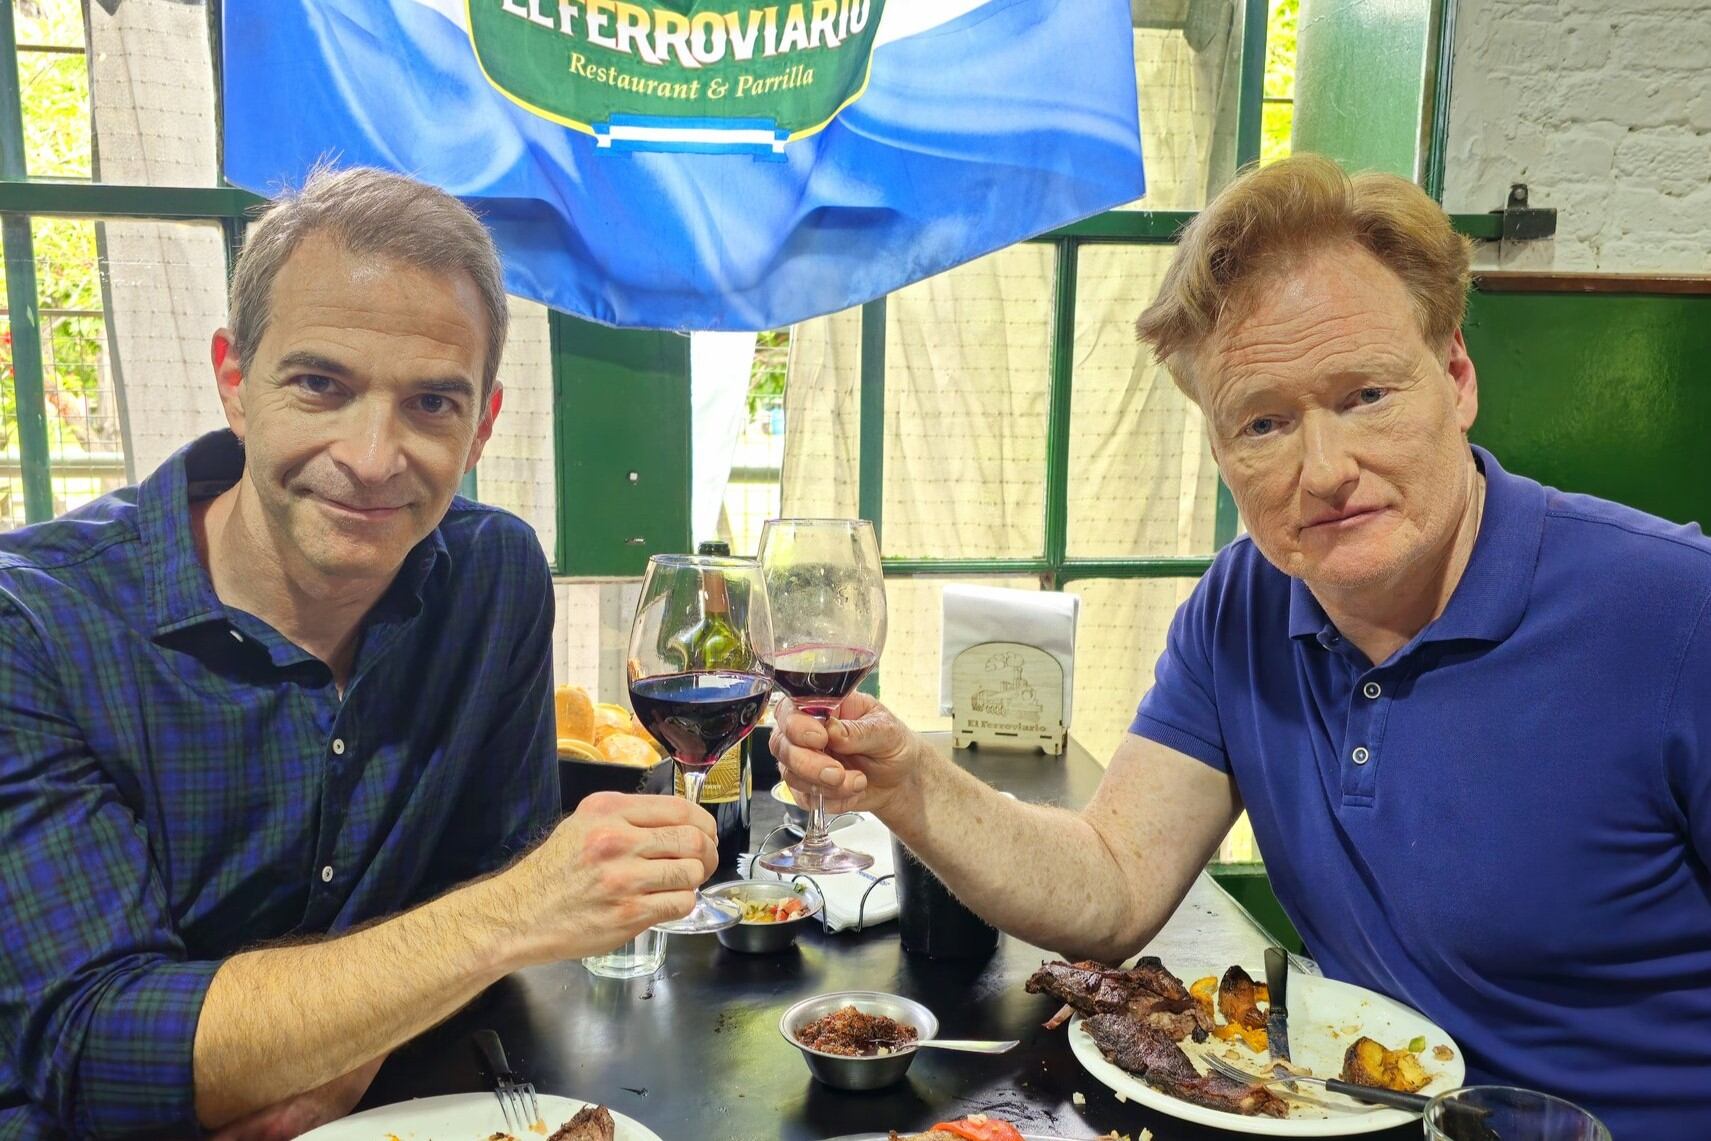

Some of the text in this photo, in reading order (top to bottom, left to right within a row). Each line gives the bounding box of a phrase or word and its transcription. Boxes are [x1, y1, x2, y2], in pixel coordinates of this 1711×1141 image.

[558, 0, 871, 68] FERROVIARIO
[569, 52, 815, 99] Restaurant & Parrilla
[980, 720, 1047, 732] Ferroviario
